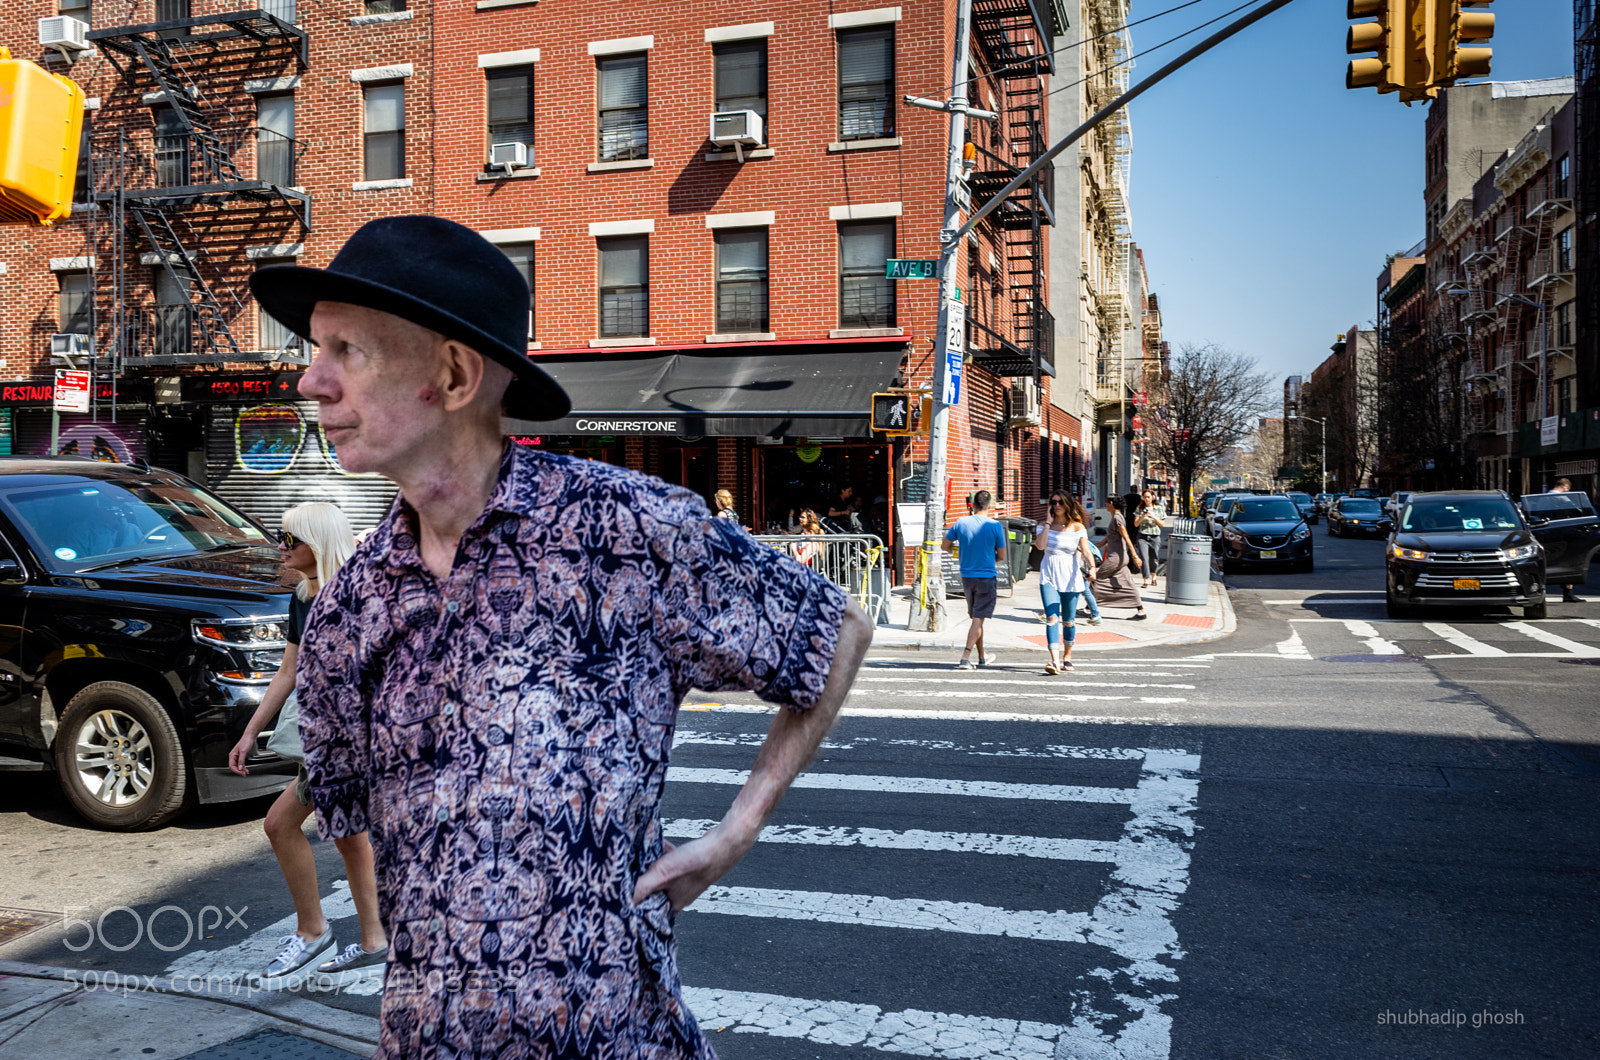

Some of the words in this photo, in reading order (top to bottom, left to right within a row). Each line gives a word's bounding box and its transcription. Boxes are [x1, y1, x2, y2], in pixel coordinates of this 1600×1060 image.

[892, 262, 916, 276] AVE
[924, 262, 933, 276] B
[949, 327, 962, 347] 20
[3, 386, 53, 401] RESTAUR
[211, 381, 239, 394] 1500
[243, 380, 272, 394] FEET
[575, 419, 677, 432] CORNERSTONE
